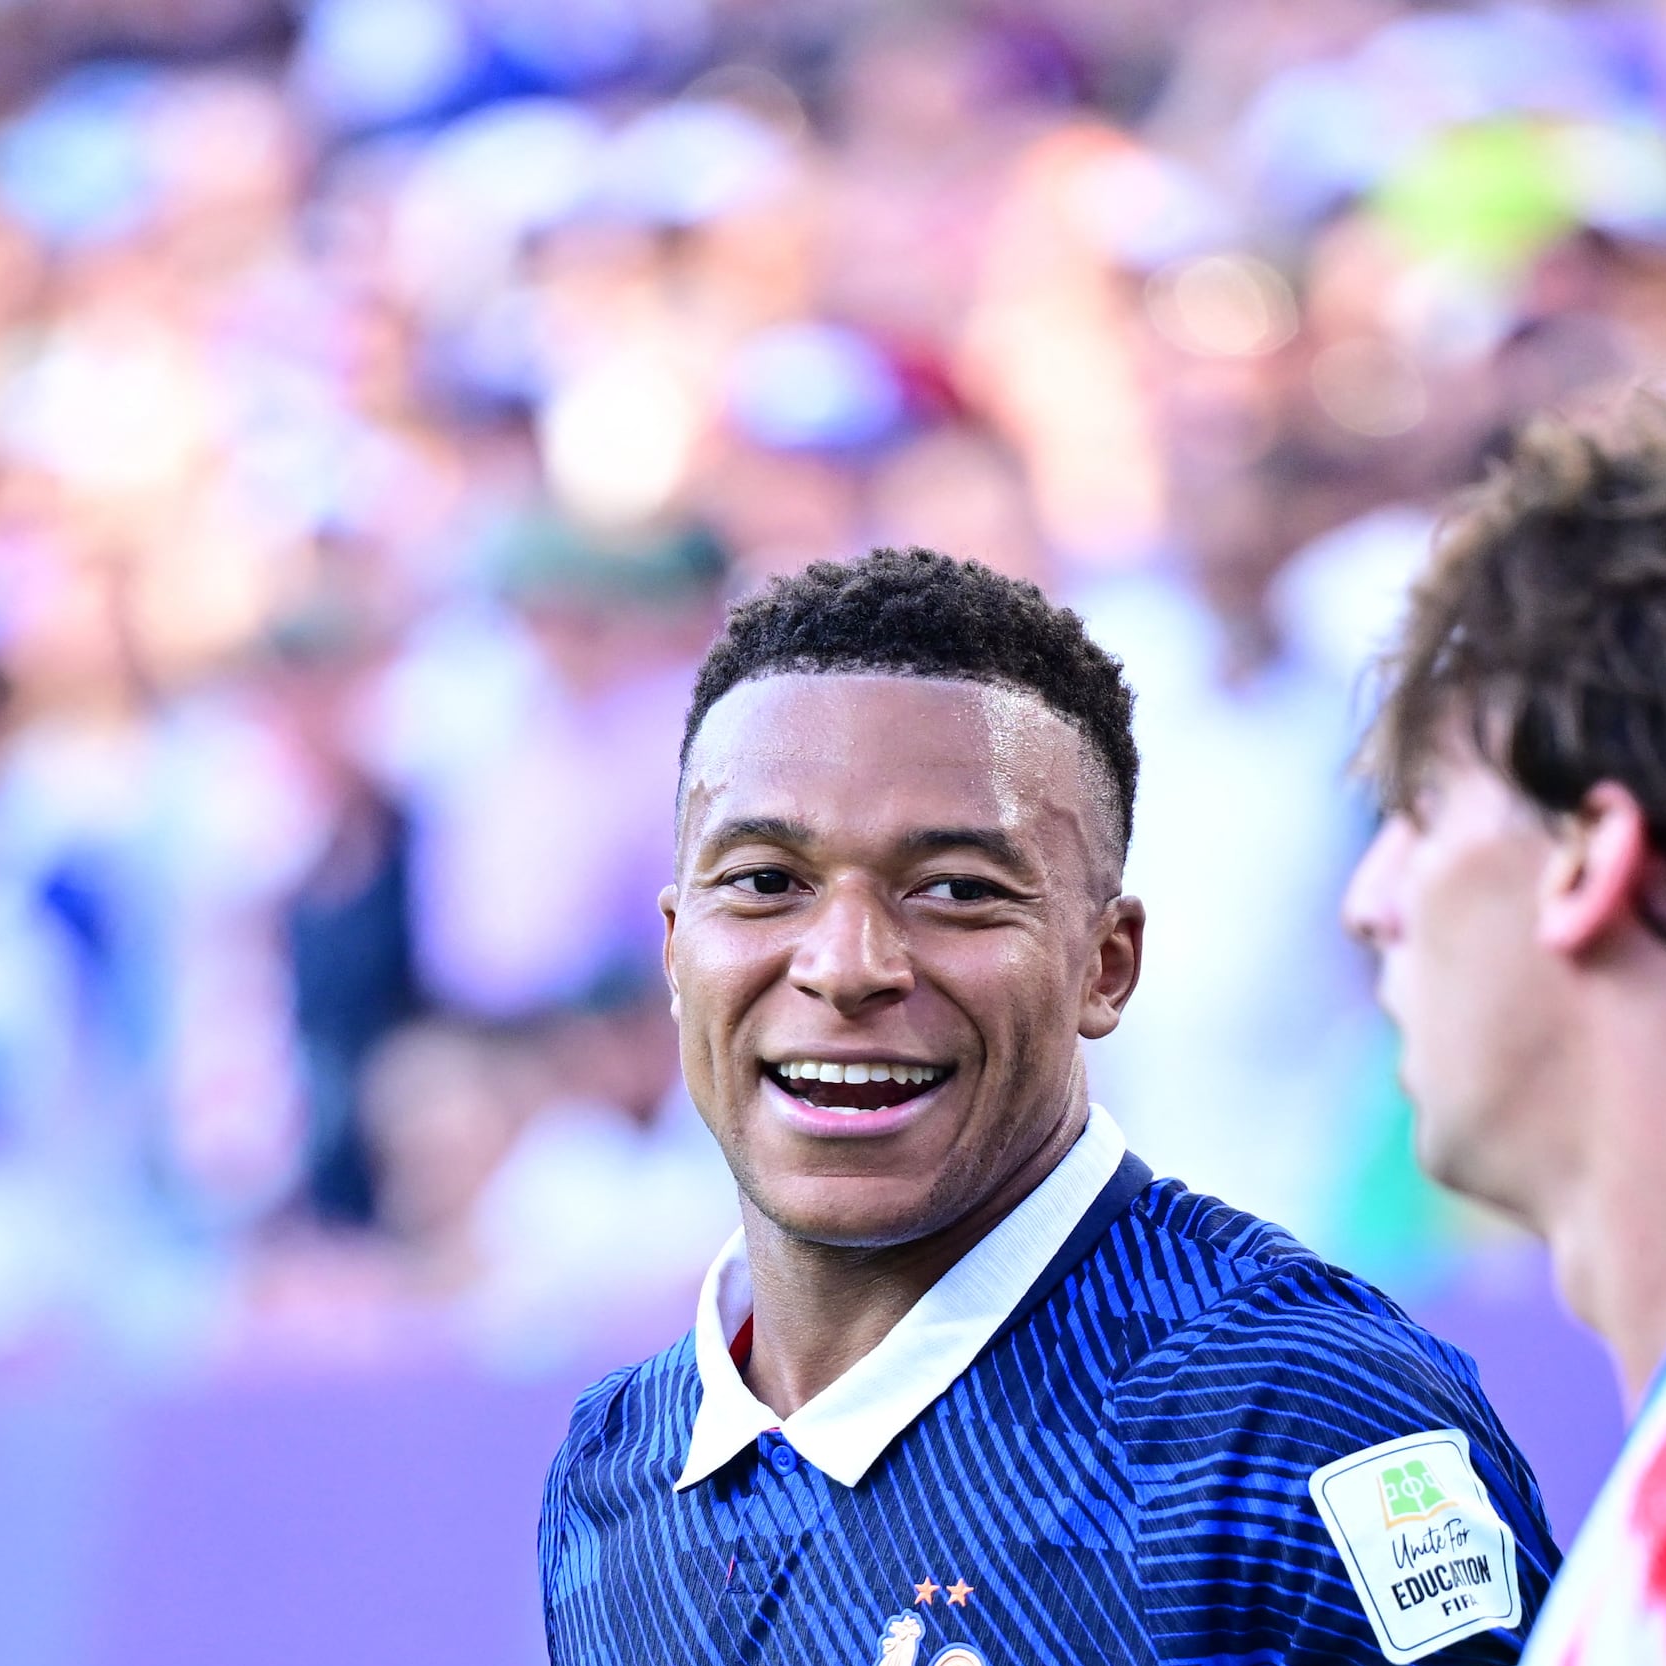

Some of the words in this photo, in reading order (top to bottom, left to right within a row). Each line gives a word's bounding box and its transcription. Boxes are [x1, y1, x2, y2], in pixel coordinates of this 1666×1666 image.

[1392, 1526, 1446, 1569] Unite
[1443, 1518, 1471, 1553] For
[1391, 1554, 1492, 1611] EDUCATION
[1441, 1593, 1479, 1617] FIFA
